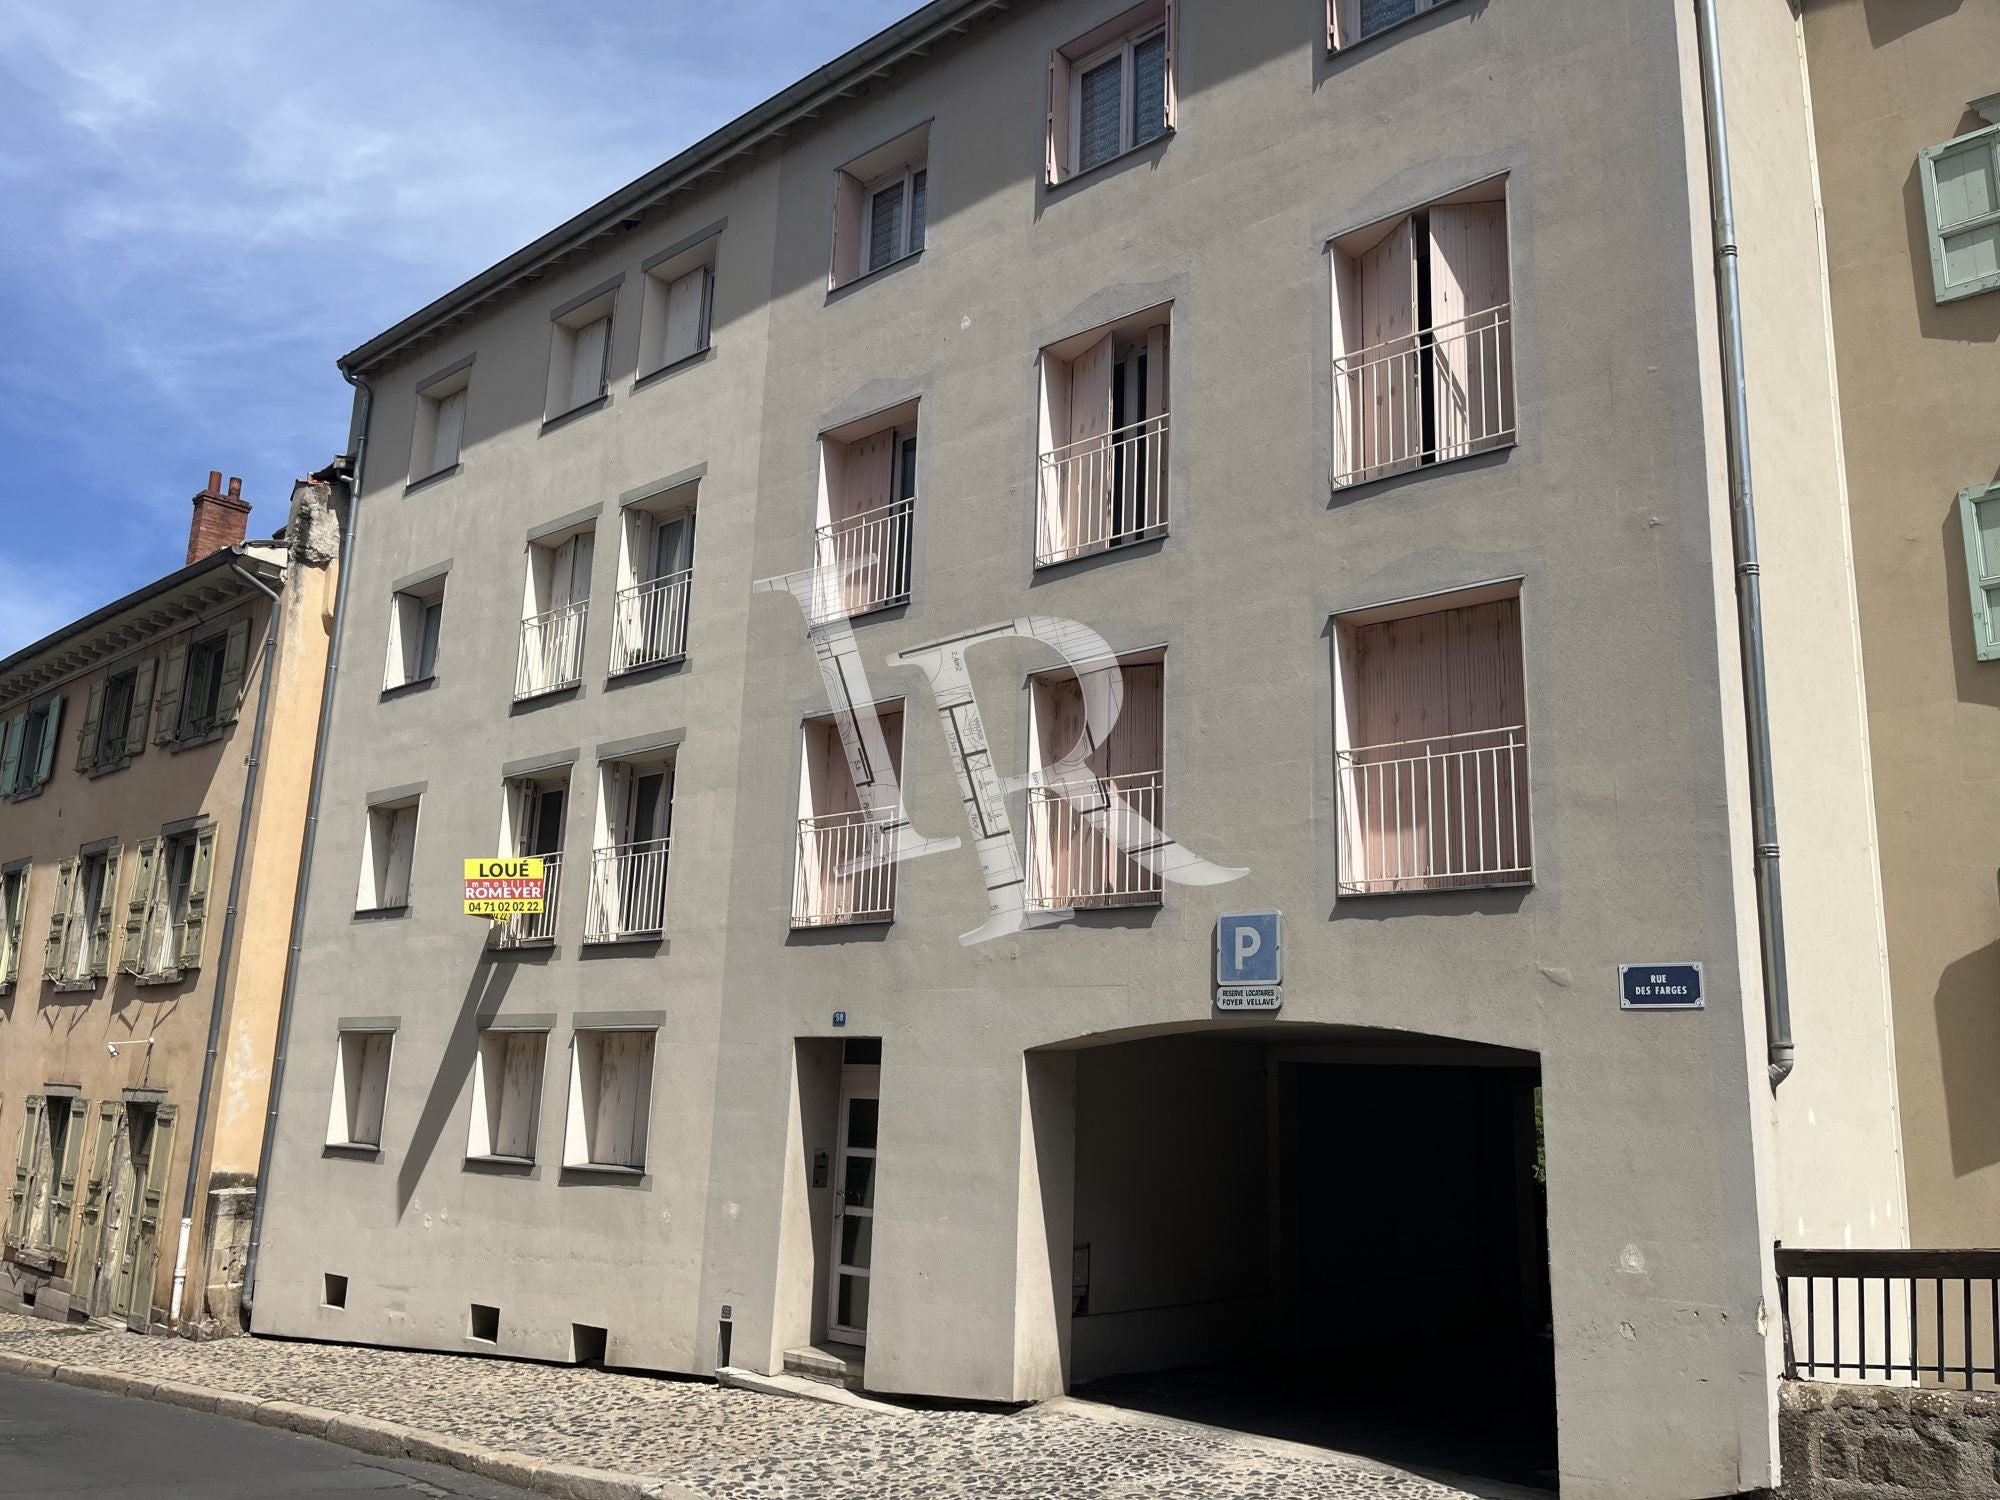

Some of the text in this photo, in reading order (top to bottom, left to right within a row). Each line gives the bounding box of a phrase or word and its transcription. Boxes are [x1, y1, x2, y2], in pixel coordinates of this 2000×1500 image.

[479, 860, 529, 878] LOUÉ
[465, 887, 542, 899] ROMEYER
[468, 902, 539, 912] 04 71 02 02 22
[1235, 926, 1261, 970] P
[1650, 974, 1667, 984] RUE
[1635, 985, 1687, 995] DES FARGES
[1222, 998, 1275, 1006] FOYER VELLAVE
